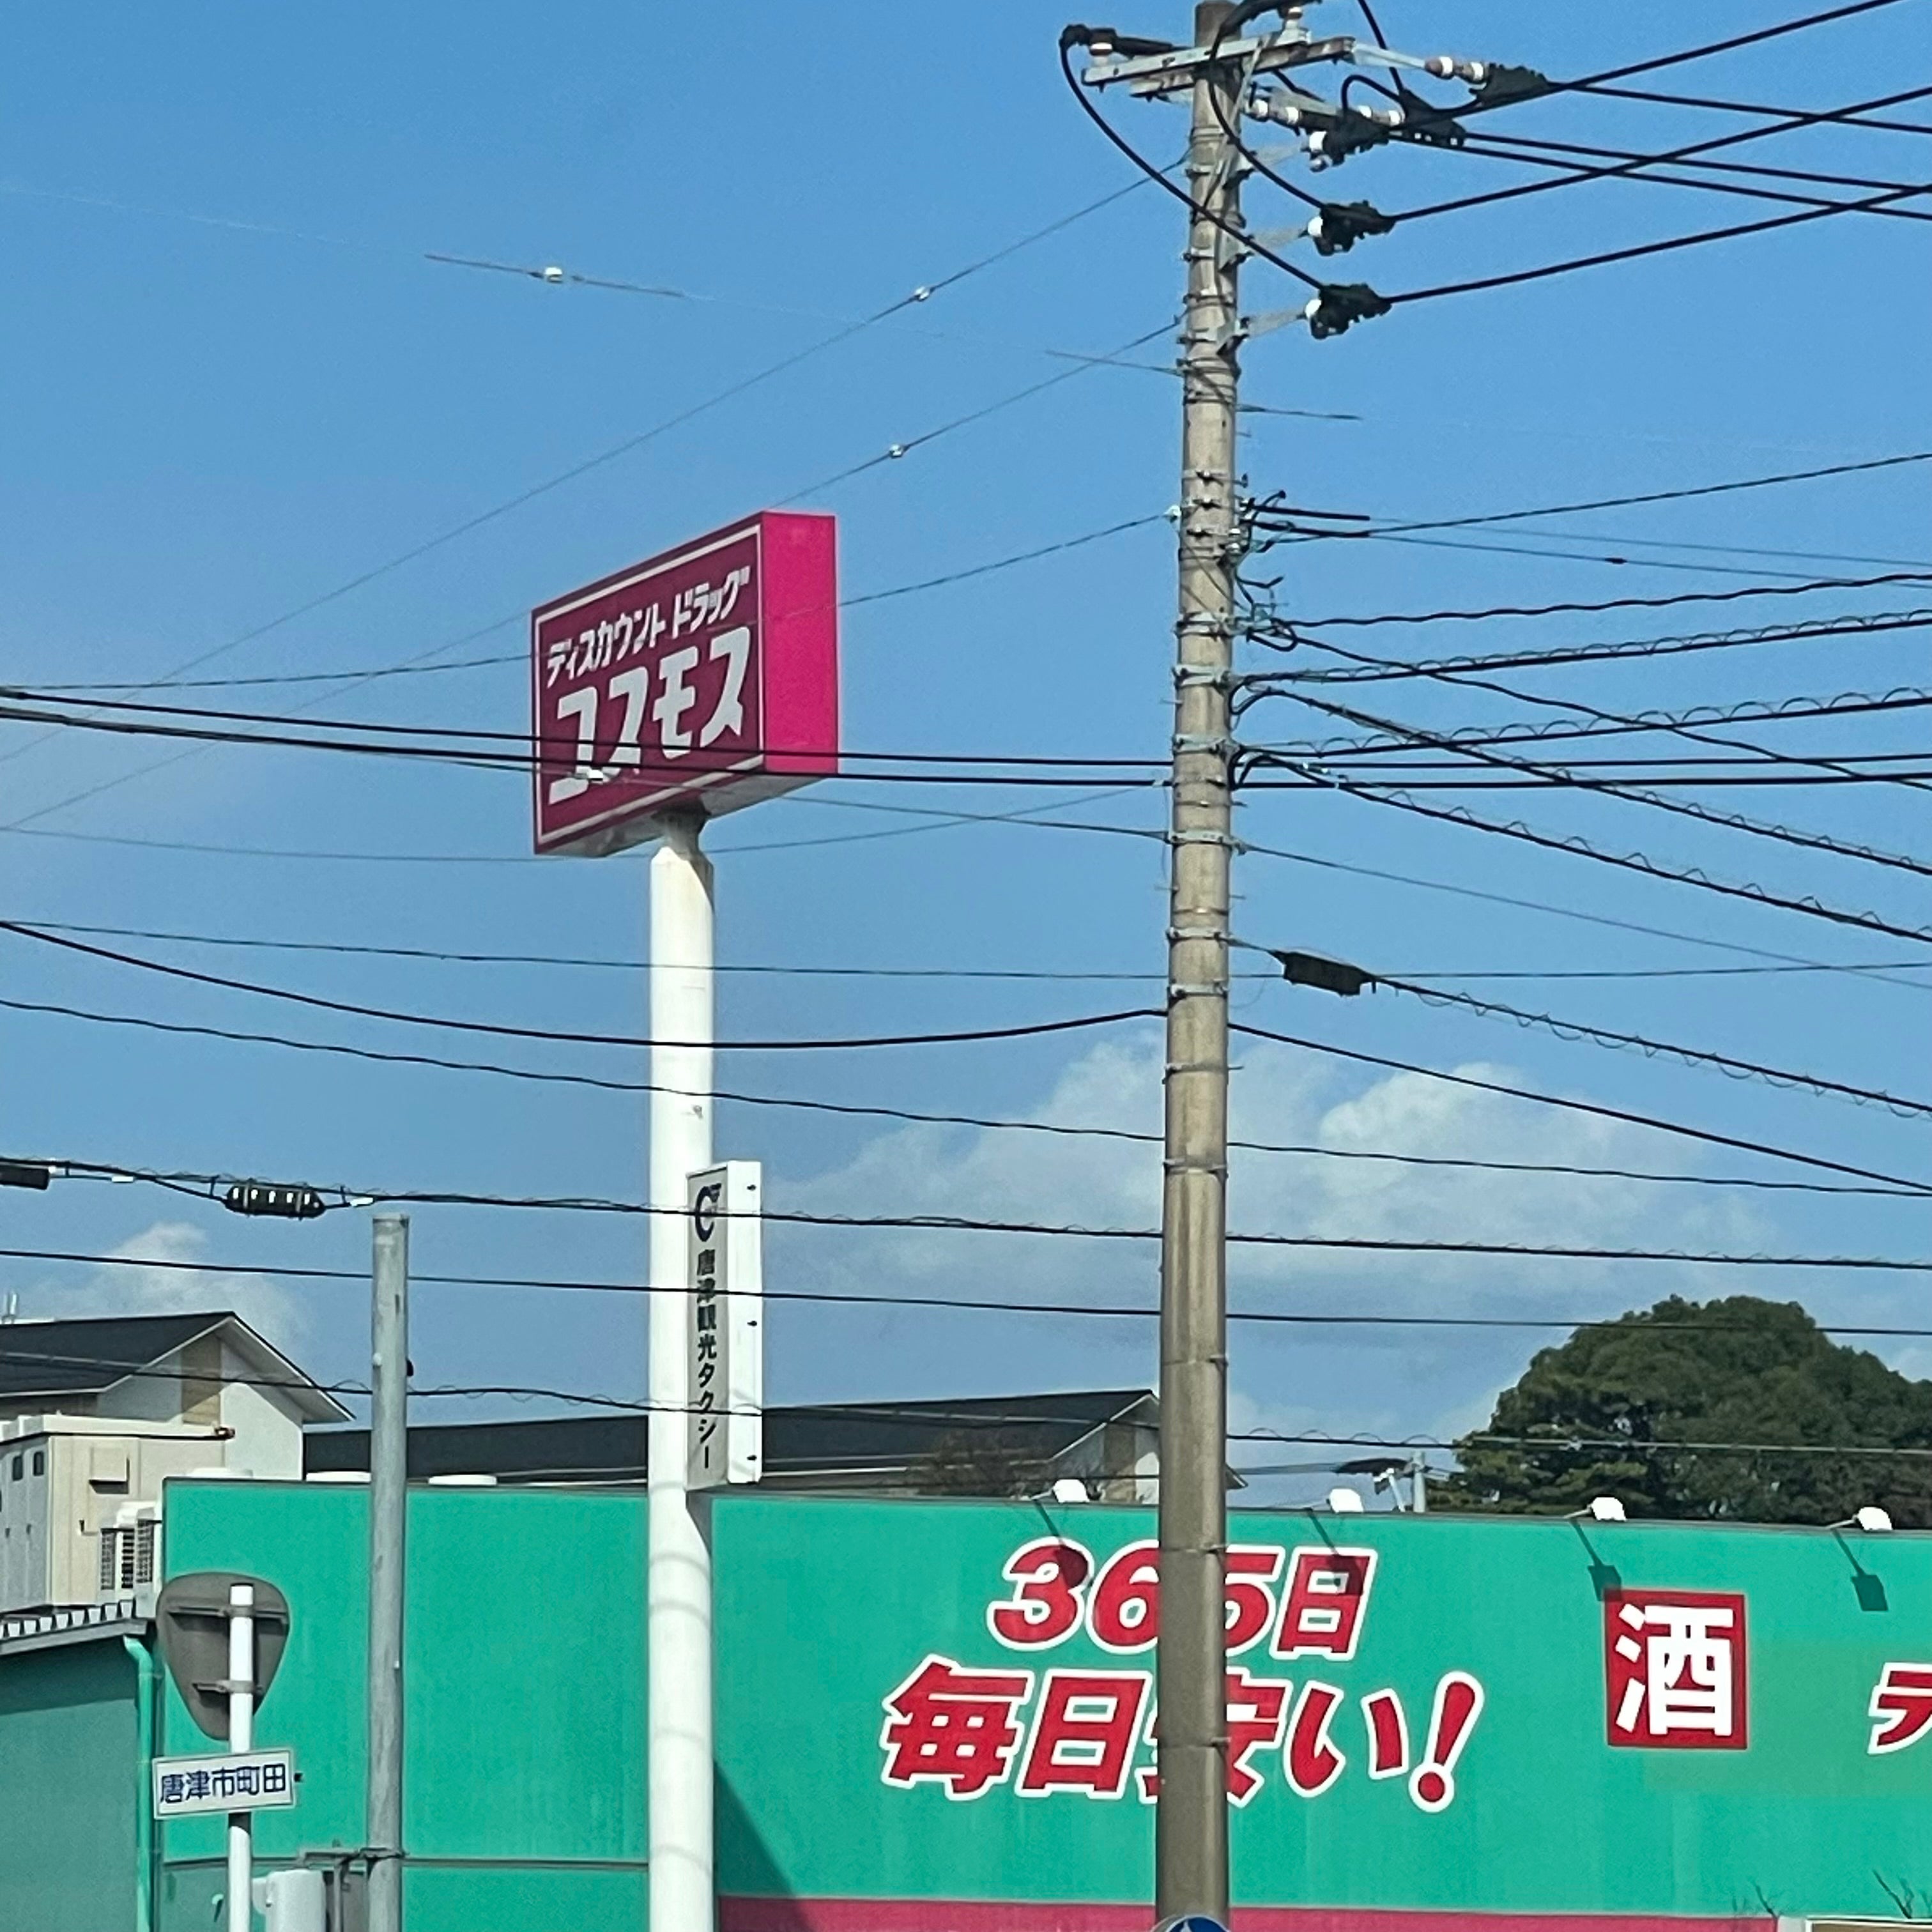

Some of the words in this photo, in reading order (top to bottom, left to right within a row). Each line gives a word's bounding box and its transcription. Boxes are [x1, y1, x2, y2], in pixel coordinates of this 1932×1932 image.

[547, 603, 666, 689] ディスカウント
[672, 565, 751, 639] ドラッグ
[549, 626, 750, 805] コスモス
[987, 1537, 1378, 1660] 365日
[1614, 1603, 1734, 1736] 酒
[160, 1763, 286, 1804] 唐津市町田
